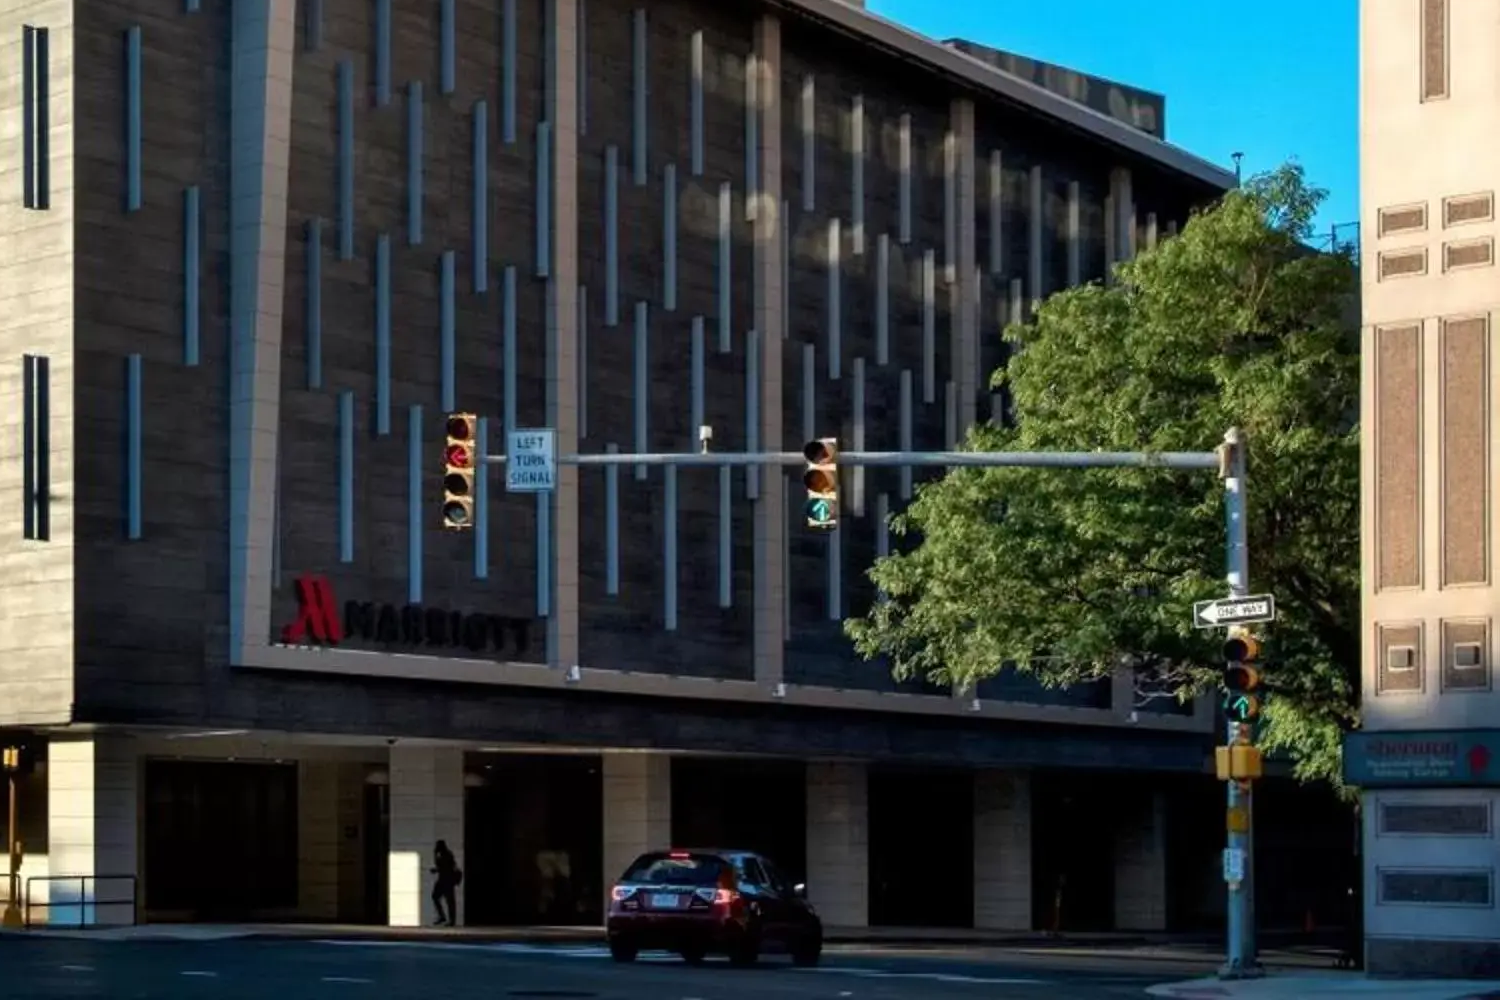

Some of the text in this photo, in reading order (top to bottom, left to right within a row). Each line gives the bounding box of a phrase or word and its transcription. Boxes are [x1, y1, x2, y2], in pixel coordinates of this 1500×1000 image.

[517, 436, 545, 449] LEFT
[515, 455, 545, 467] TURN
[511, 472, 550, 484] SIGNAL
[1217, 603, 1264, 617] ONE WAY
[344, 599, 534, 654] MARRIOTT
